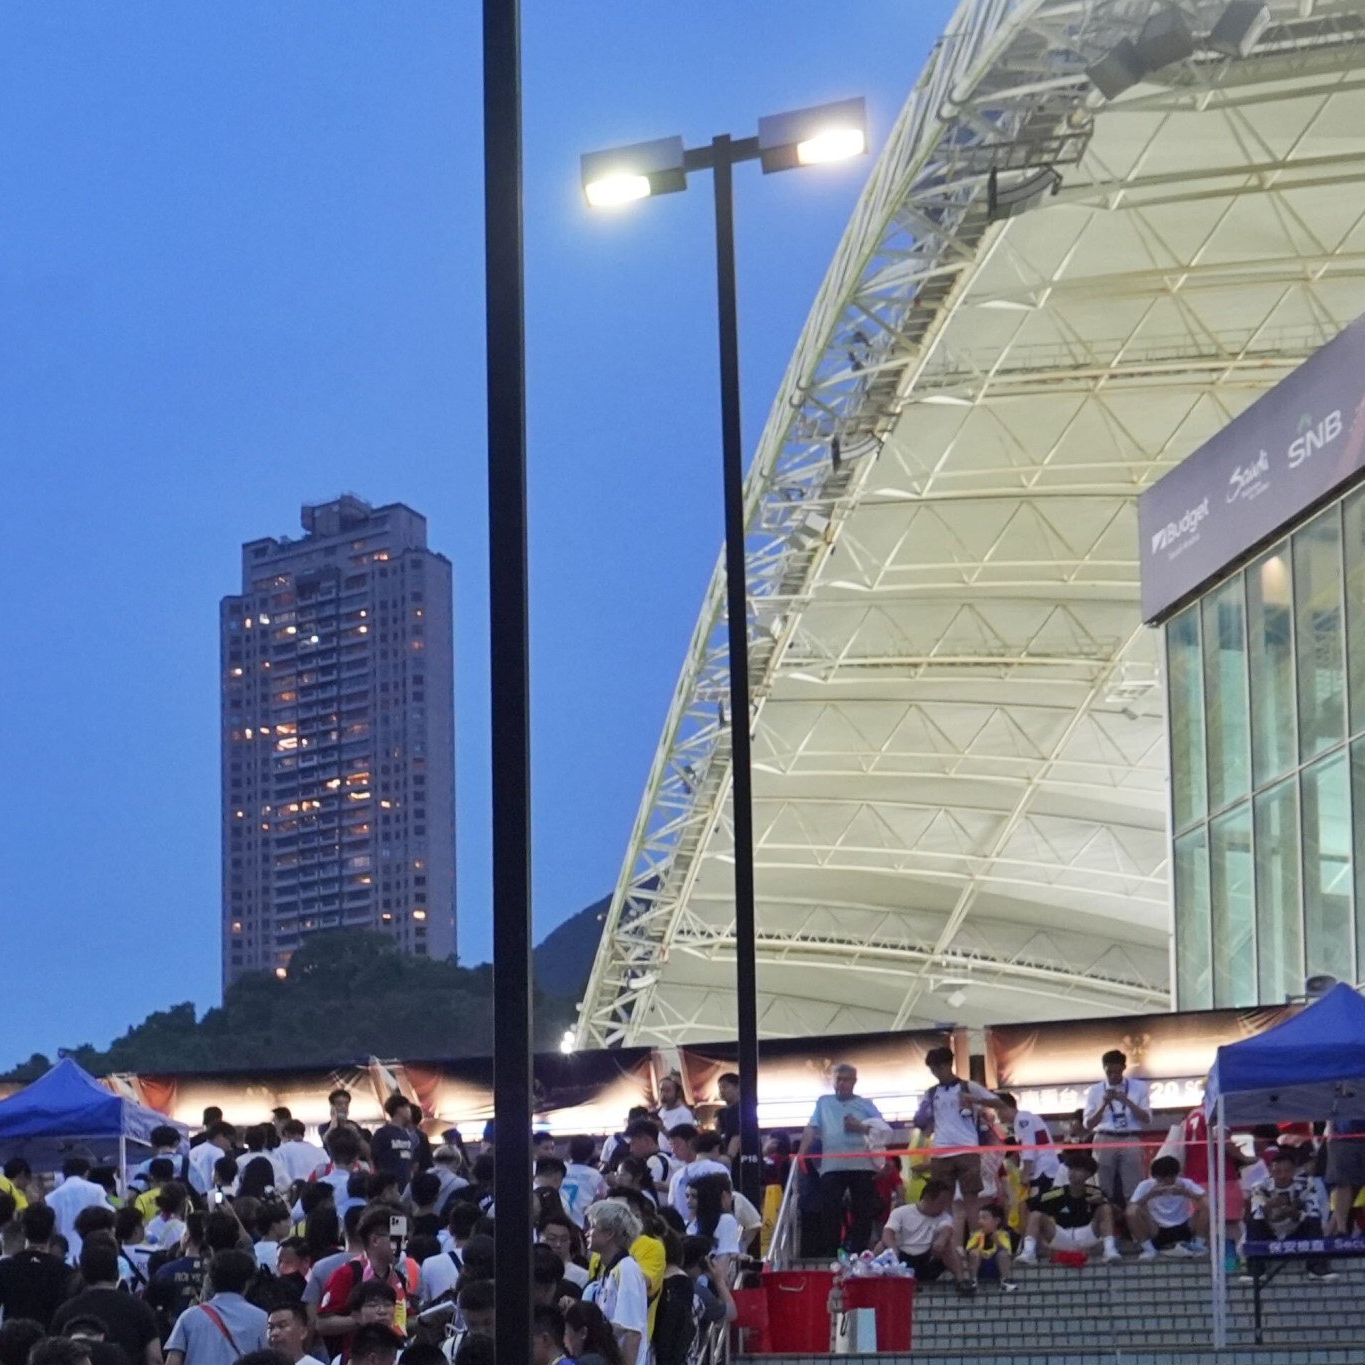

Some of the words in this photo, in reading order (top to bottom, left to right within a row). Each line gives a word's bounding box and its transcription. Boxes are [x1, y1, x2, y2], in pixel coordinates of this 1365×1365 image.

[1288, 409, 1343, 468] SNB
[1162, 497, 1210, 550] Budget
[740, 1154, 758, 1163] P18
